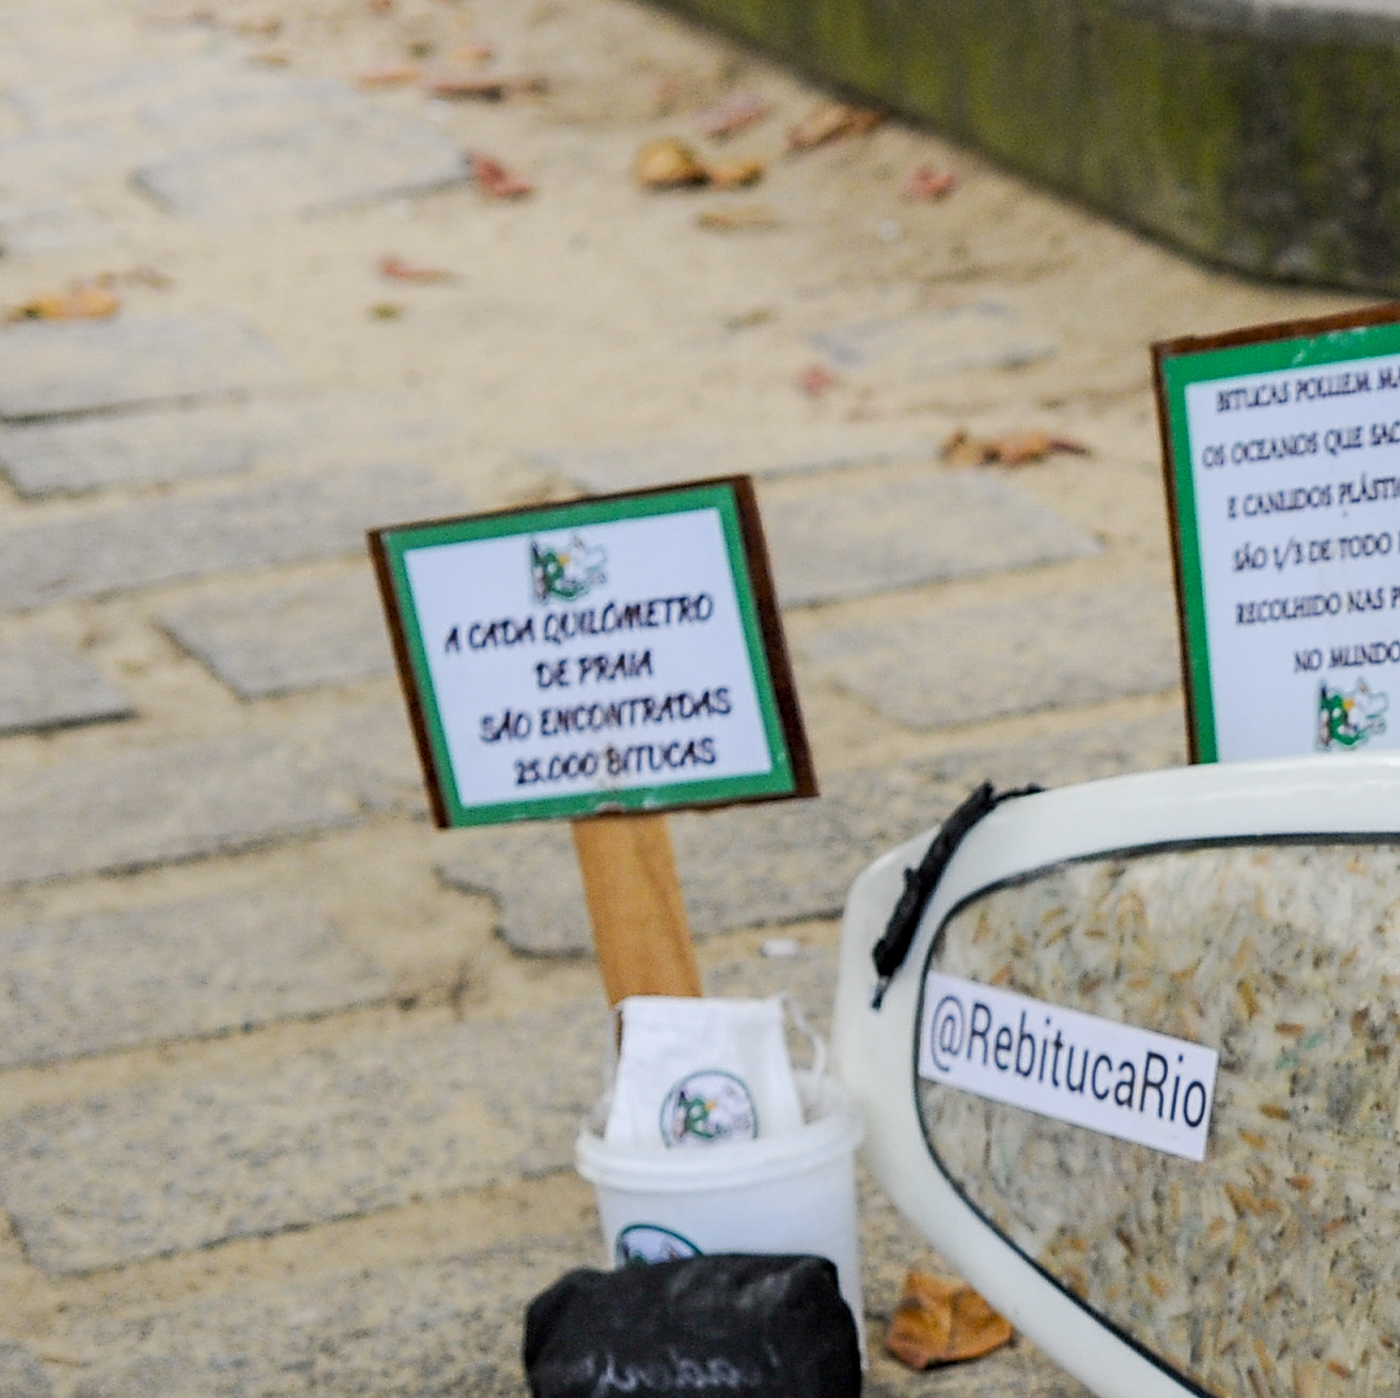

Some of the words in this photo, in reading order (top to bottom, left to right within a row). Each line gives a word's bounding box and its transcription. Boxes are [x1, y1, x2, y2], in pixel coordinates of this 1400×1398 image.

[1216, 381, 1289, 413] BITUCAS
[1202, 445, 1224, 468] OS
[1231, 431, 1318, 464] OCEANOS
[1324, 425, 1363, 455] QUE
[1228, 496, 1237, 519] E
[1243, 483, 1331, 517] CANUDOS
[1309, 538, 1330, 563] DE
[1339, 531, 1392, 559] TODO
[1235, 591, 1341, 625] RECOLHIDO
[1347, 586, 1384, 612] NAS
[444, 627, 460, 653] A
[469, 617, 536, 650] CADA
[535, 659, 569, 688] DE
[577, 650, 653, 685] PRAIA
[1294, 648, 1322, 673] NO
[540, 687, 732, 737] ENCONTRADAS
[606, 737, 716, 776] BITUCAS
[931, 995, 1207, 1128] @RebitucaRio
